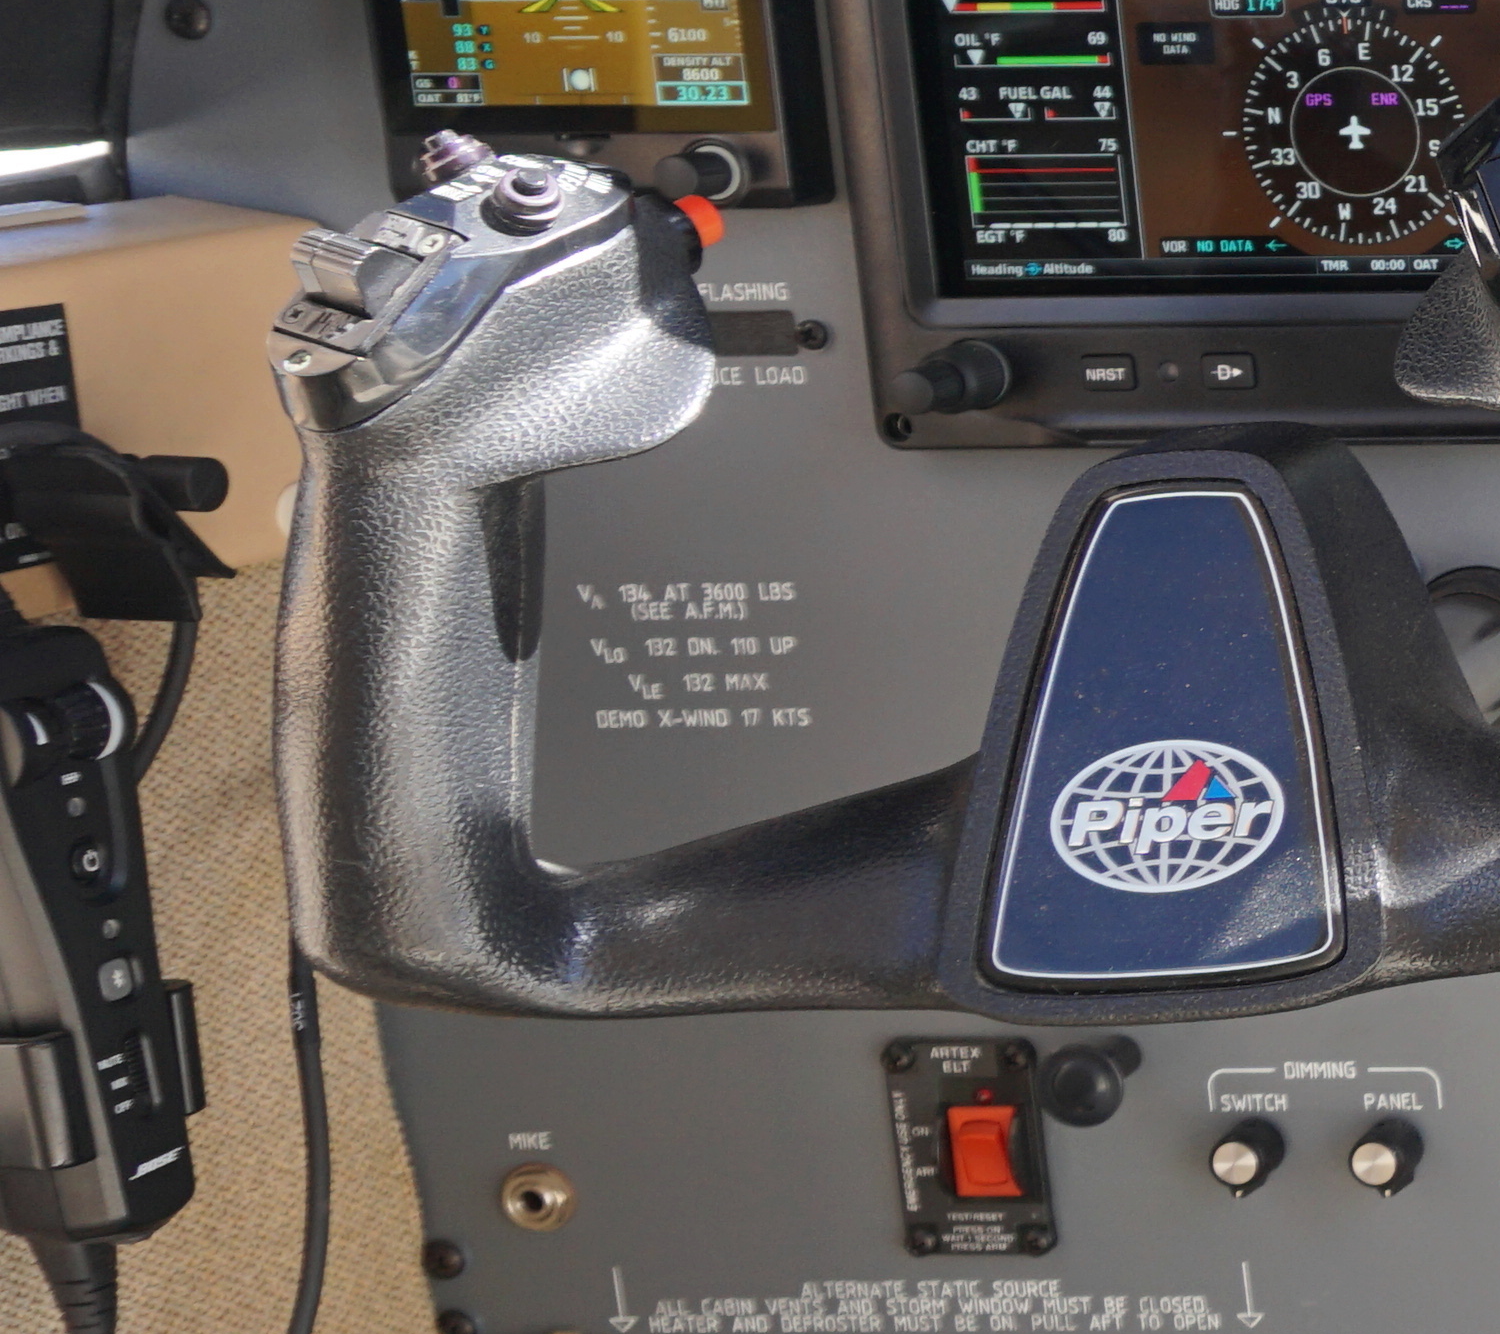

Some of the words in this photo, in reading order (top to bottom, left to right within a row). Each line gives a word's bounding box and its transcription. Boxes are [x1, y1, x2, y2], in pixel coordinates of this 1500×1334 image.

[1086, 368, 1125, 382] NRST
[618, 583, 651, 603] 134
[664, 582, 691, 601] AT
[701, 582, 747, 601] 3600
[758, 582, 796, 601] LBS
[1068, 796, 1273, 854] Piper
[1284, 1061, 1356, 1080] DIMMING
[1220, 1094, 1287, 1113] SWITCH
[1364, 1093, 1423, 1112] PANEL
[509, 1131, 552, 1151] MIKE
[801, 1280, 905, 1300] ALTERNATE
[917, 1280, 978, 1298] STATIC
[993, 1279, 1061, 1298] SOURCE
